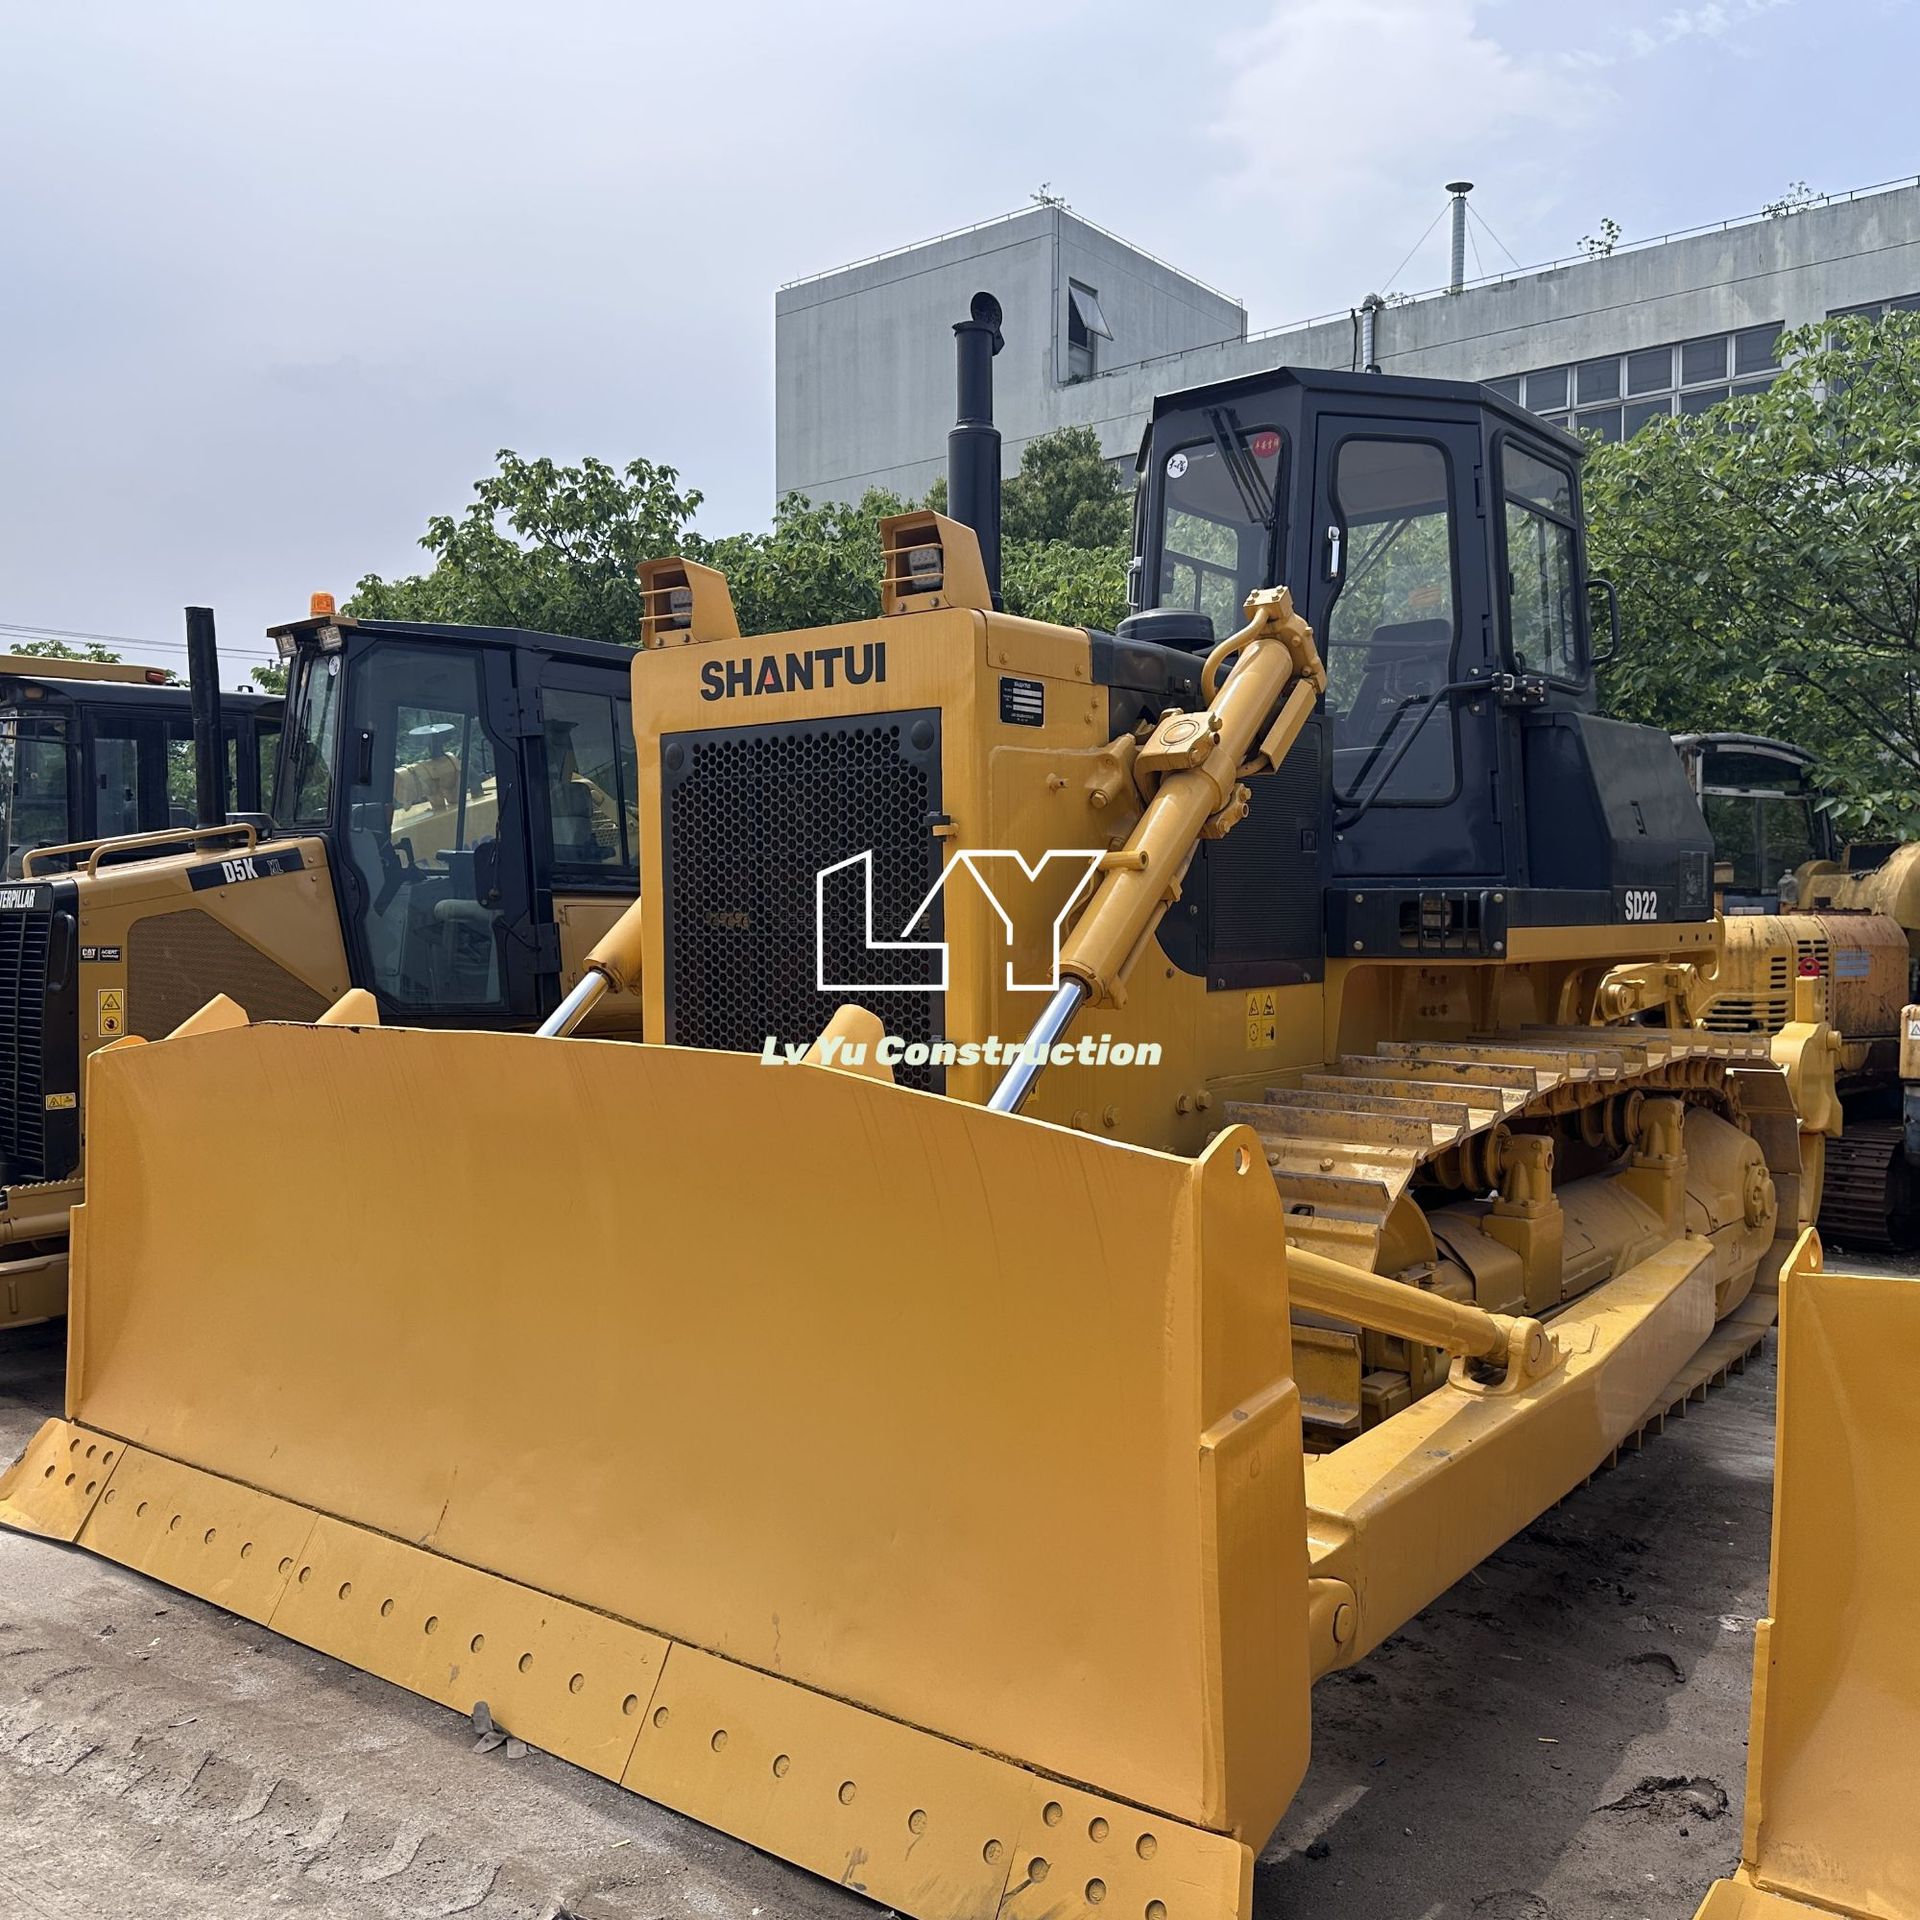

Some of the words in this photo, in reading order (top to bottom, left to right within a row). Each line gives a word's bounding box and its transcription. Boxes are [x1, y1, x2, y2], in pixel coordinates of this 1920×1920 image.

[701, 642, 886, 701] SHANTUI
[221, 858, 259, 883] D5K
[1625, 890, 1657, 920] SD22
[82, 948, 96, 956] CAT
